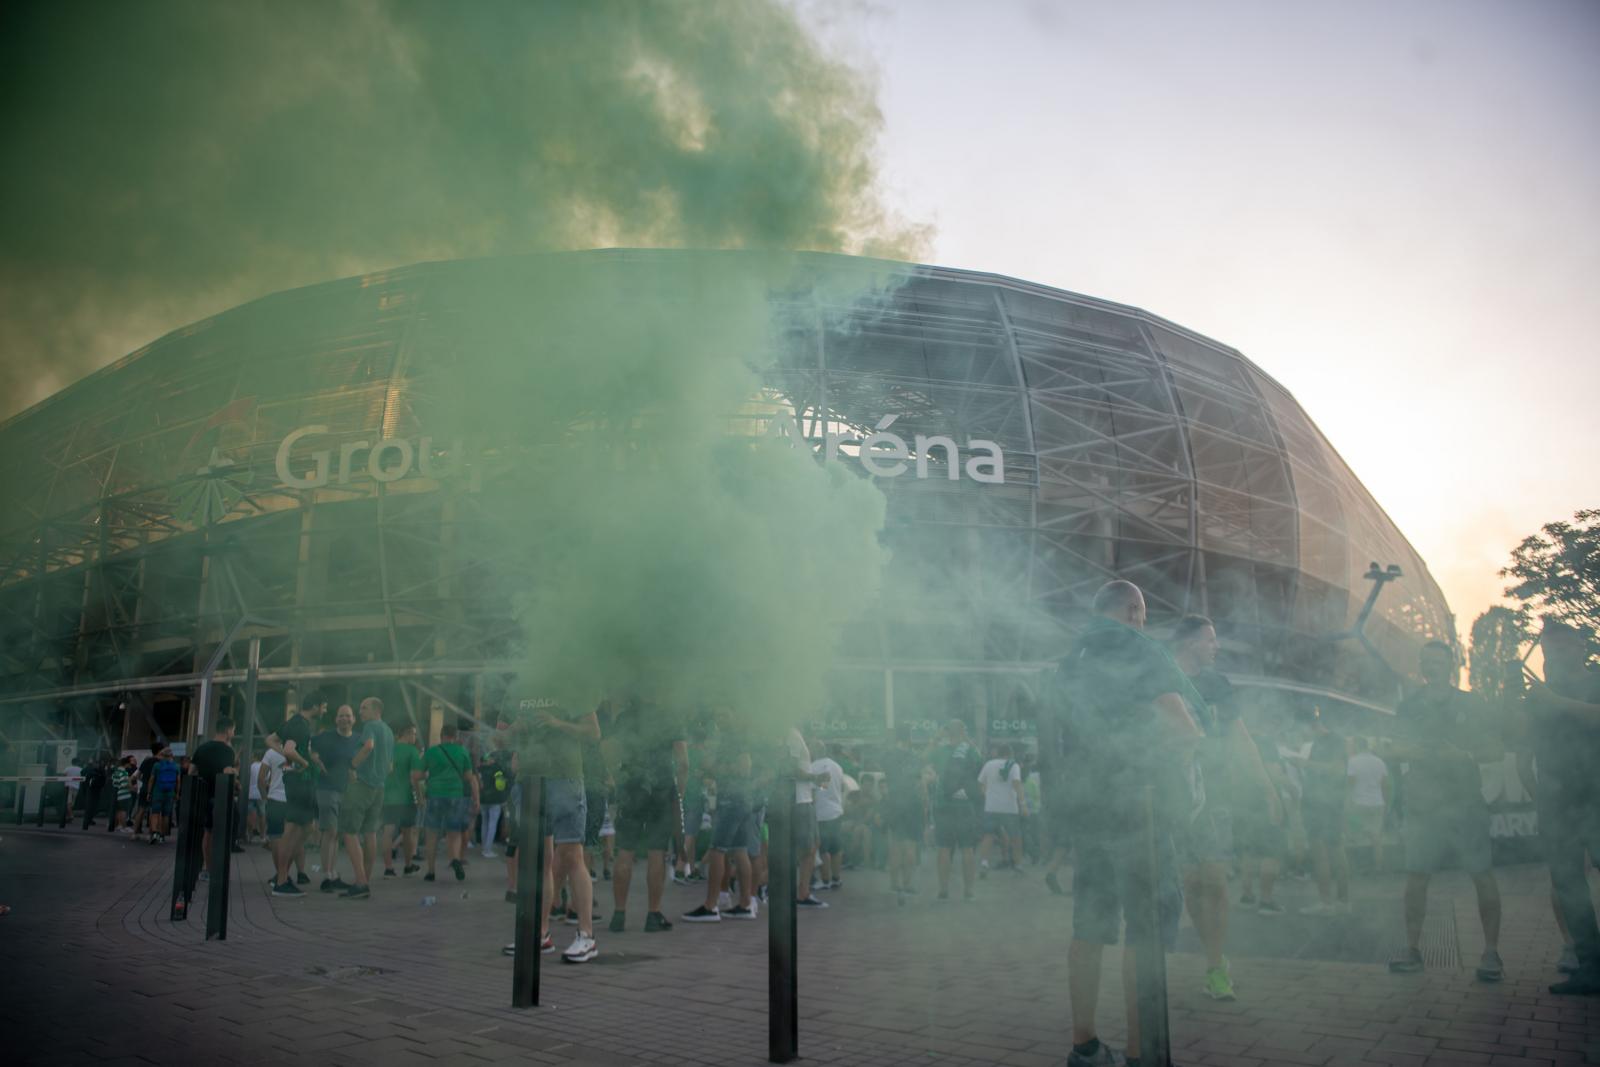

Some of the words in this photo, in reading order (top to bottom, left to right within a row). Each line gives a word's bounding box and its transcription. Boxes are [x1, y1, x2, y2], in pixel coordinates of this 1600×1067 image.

[763, 408, 1006, 484] Aréna
[521, 699, 557, 711] FRAD
[1490, 812, 1539, 837] ARY
